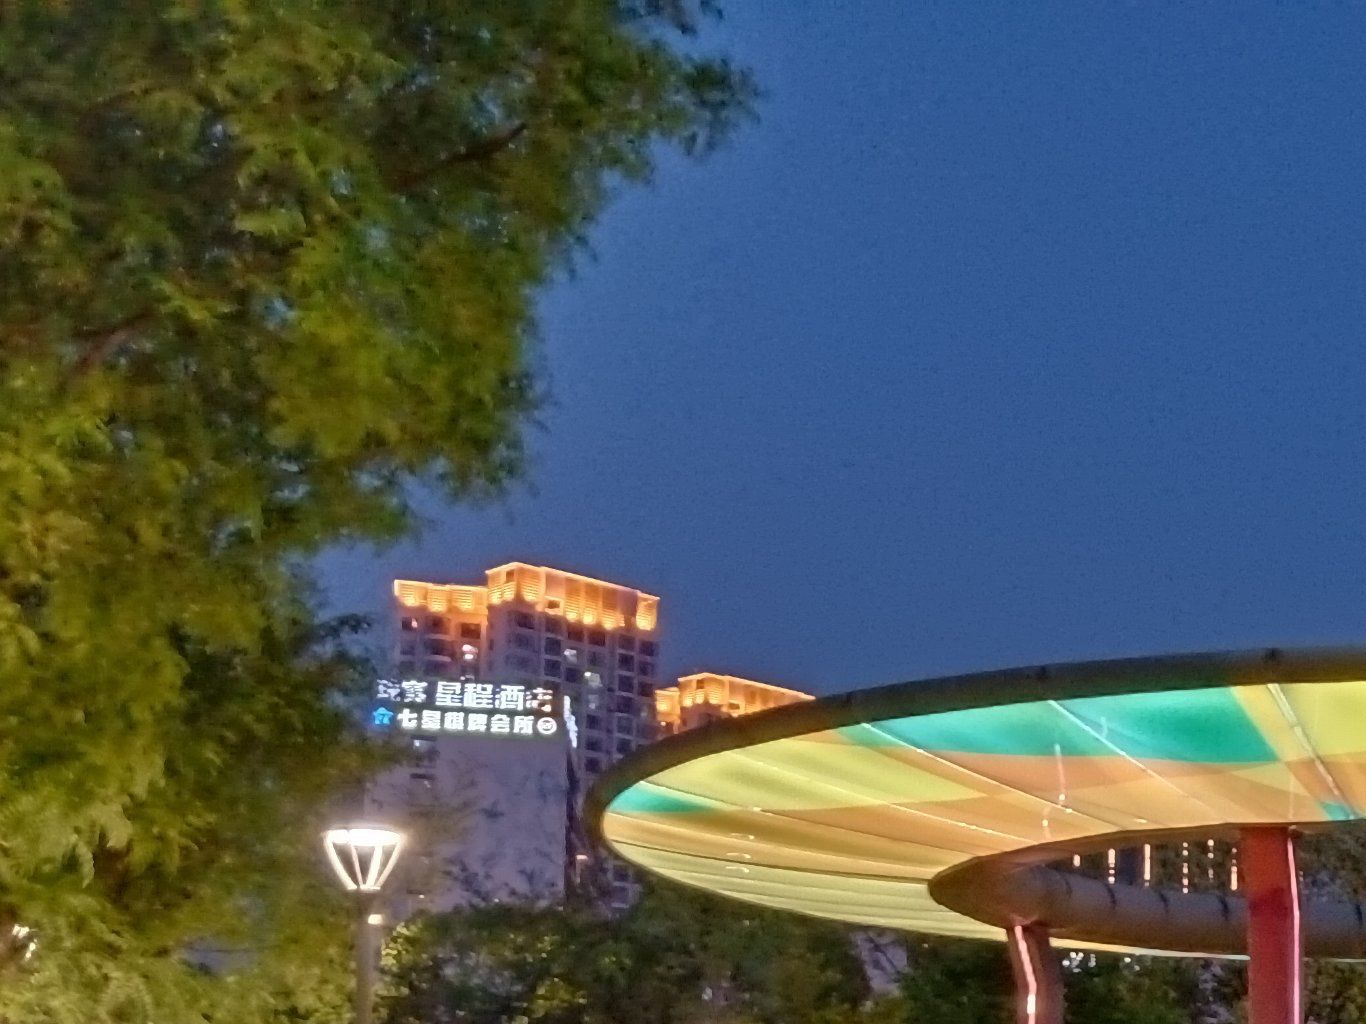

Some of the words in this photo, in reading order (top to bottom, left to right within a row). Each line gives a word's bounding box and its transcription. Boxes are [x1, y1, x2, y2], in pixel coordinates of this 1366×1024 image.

[397, 708, 535, 735] 七星棋牌会所
